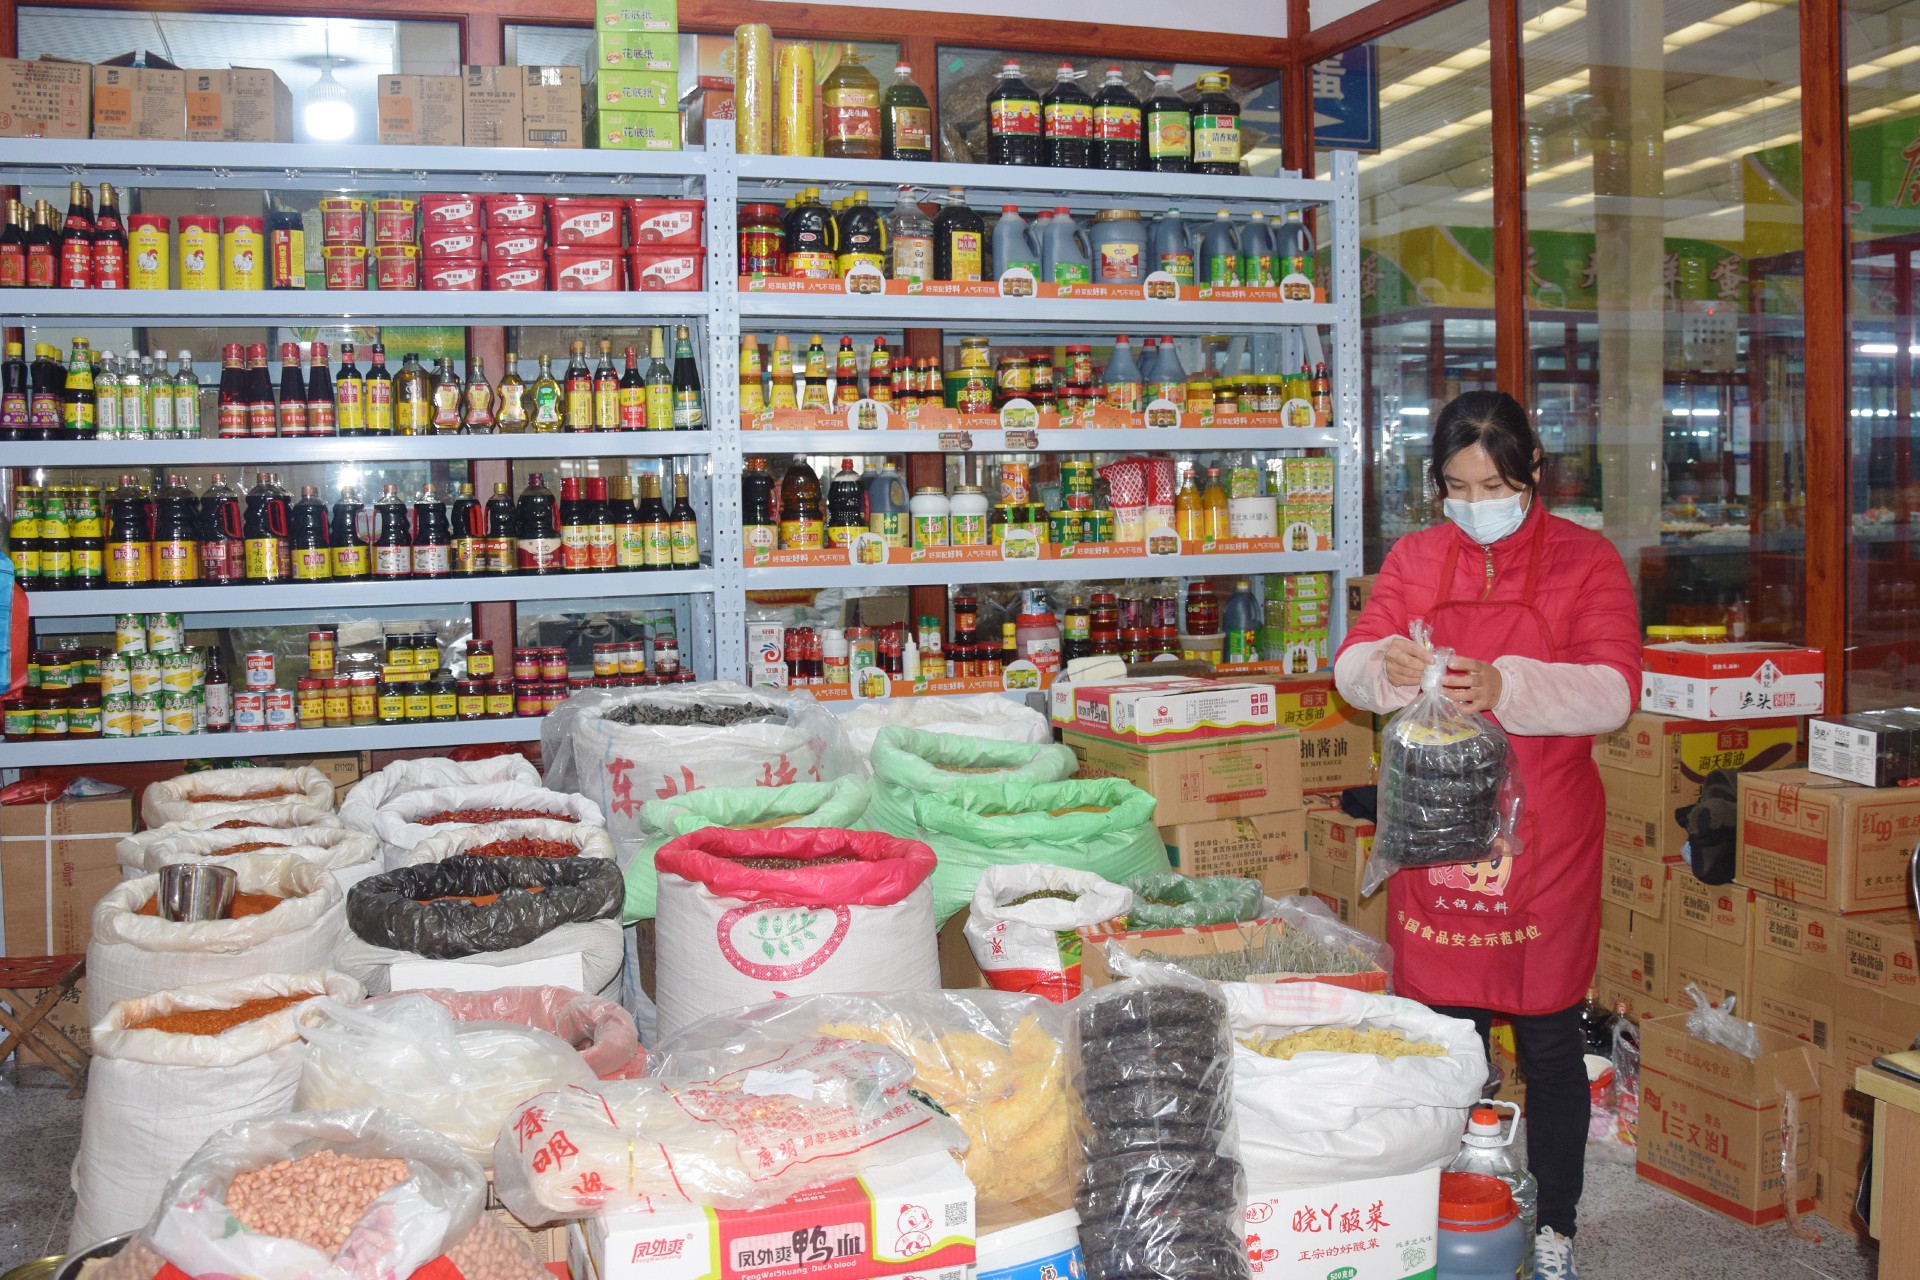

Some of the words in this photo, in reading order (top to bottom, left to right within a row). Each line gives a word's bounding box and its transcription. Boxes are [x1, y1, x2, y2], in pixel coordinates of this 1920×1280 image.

[620, 9, 653, 20] 花底纸
[622, 48, 655, 60] 花底纸
[622, 87, 654, 98] 花底纸
[623, 127, 656, 138] 花底纸
[1303, 694, 1325, 706] 海天
[1739, 691, 1772, 710] 鱼头
[1284, 708, 1325, 724] 海天酱油
[1720, 734, 1746, 748] 海天
[1698, 751, 1745, 771] 海天酱油
[1262, 831, 1287, 840] 有限公司
[1434, 896, 1508, 915] 火锅底料
[1768, 920, 1799, 940] 老抽酱油
[1850, 951, 1884, 971] 老抽酱油
[1671, 1101, 1687, 1114] 中国
[1292, 1200, 1391, 1233] 晓丫酸菜
[631, 1238, 685, 1264] 凤外爽
[738, 1225, 862, 1268] 凤外爽鸭血
[1298, 1238, 1380, 1261] 正宗的好酸菜
[811, 1264, 832, 1274] Duck
[834, 1260, 857, 1270] blood
